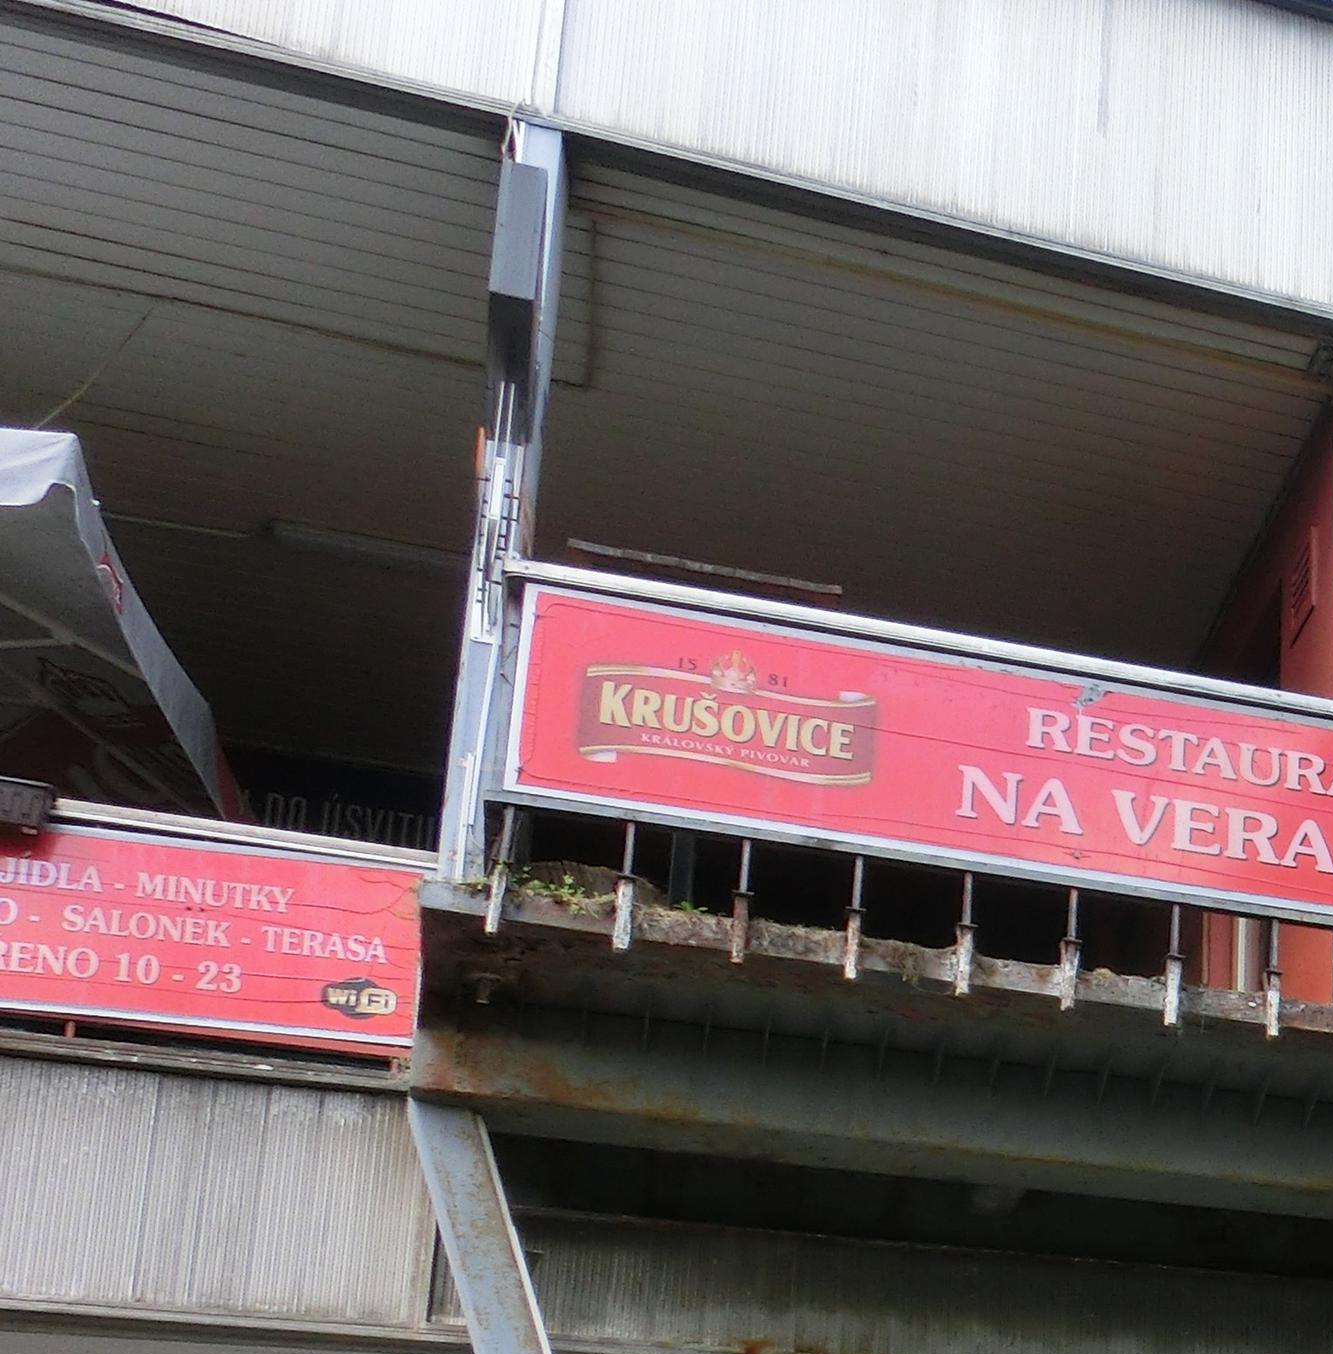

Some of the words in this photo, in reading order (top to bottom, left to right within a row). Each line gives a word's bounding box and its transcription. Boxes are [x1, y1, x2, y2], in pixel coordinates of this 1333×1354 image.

[600, 680, 855, 760] KRUŠOVICE
[740, 749, 811, 768] PIVOVAR
[956, 764, 1084, 835] NA
[1, 851, 103, 893] JÍDLA
[135, 871, 295, 913] MINUTKY
[61, 904, 232, 948] SALONEK
[261, 925, 388, 964] TERASA
[115, 952, 161, 984] 10
[196, 960, 243, 993] 23
